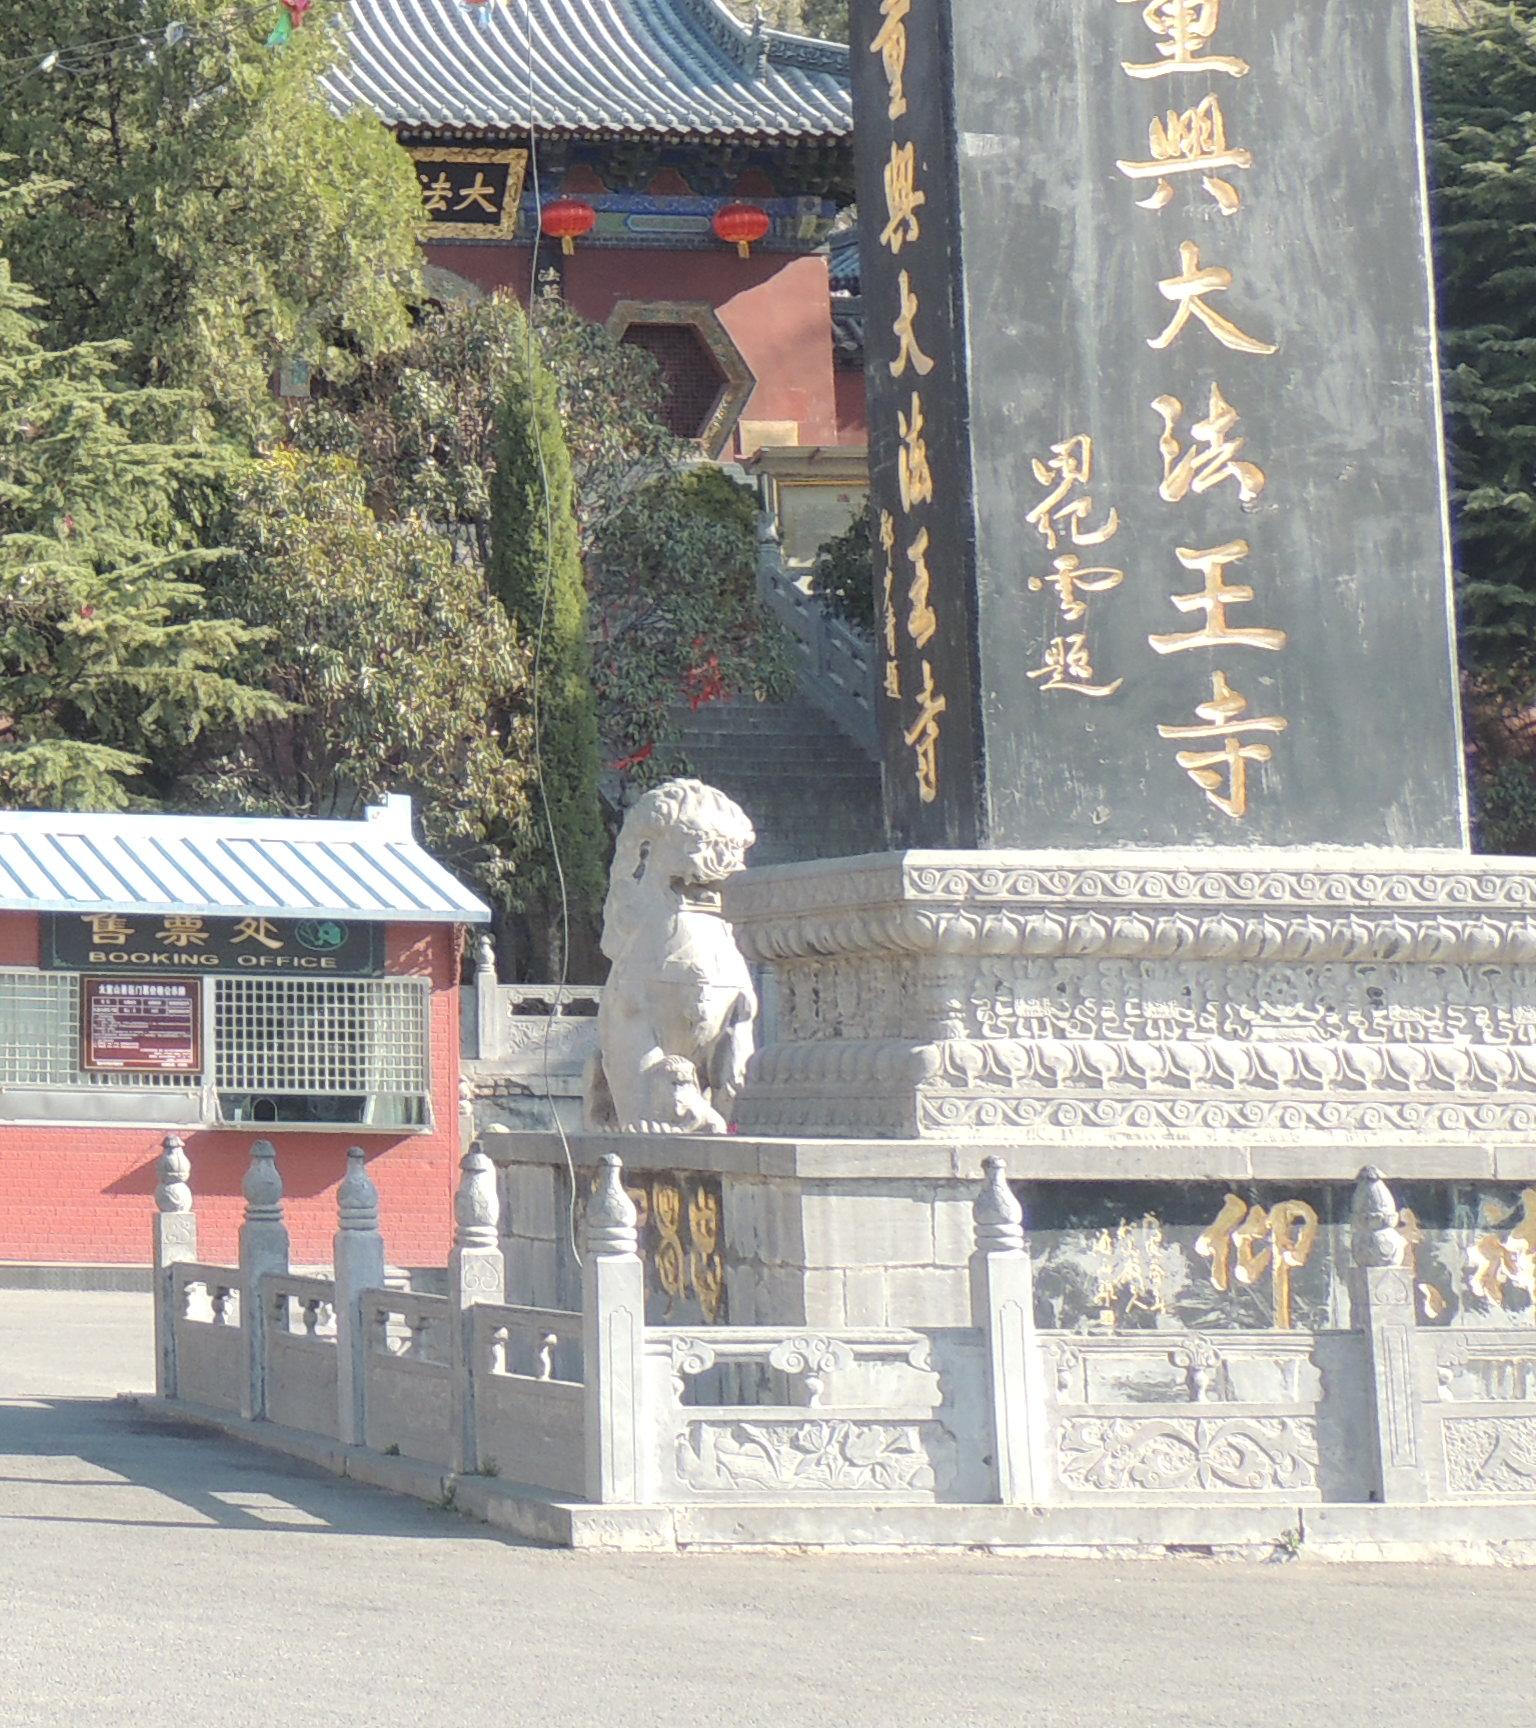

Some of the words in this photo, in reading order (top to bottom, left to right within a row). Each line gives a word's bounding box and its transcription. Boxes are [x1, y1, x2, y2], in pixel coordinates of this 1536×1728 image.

[80, 913, 285, 950] 售票处
[88, 950, 221, 966] BOOKING
[236, 954, 338, 970] OFFICE
